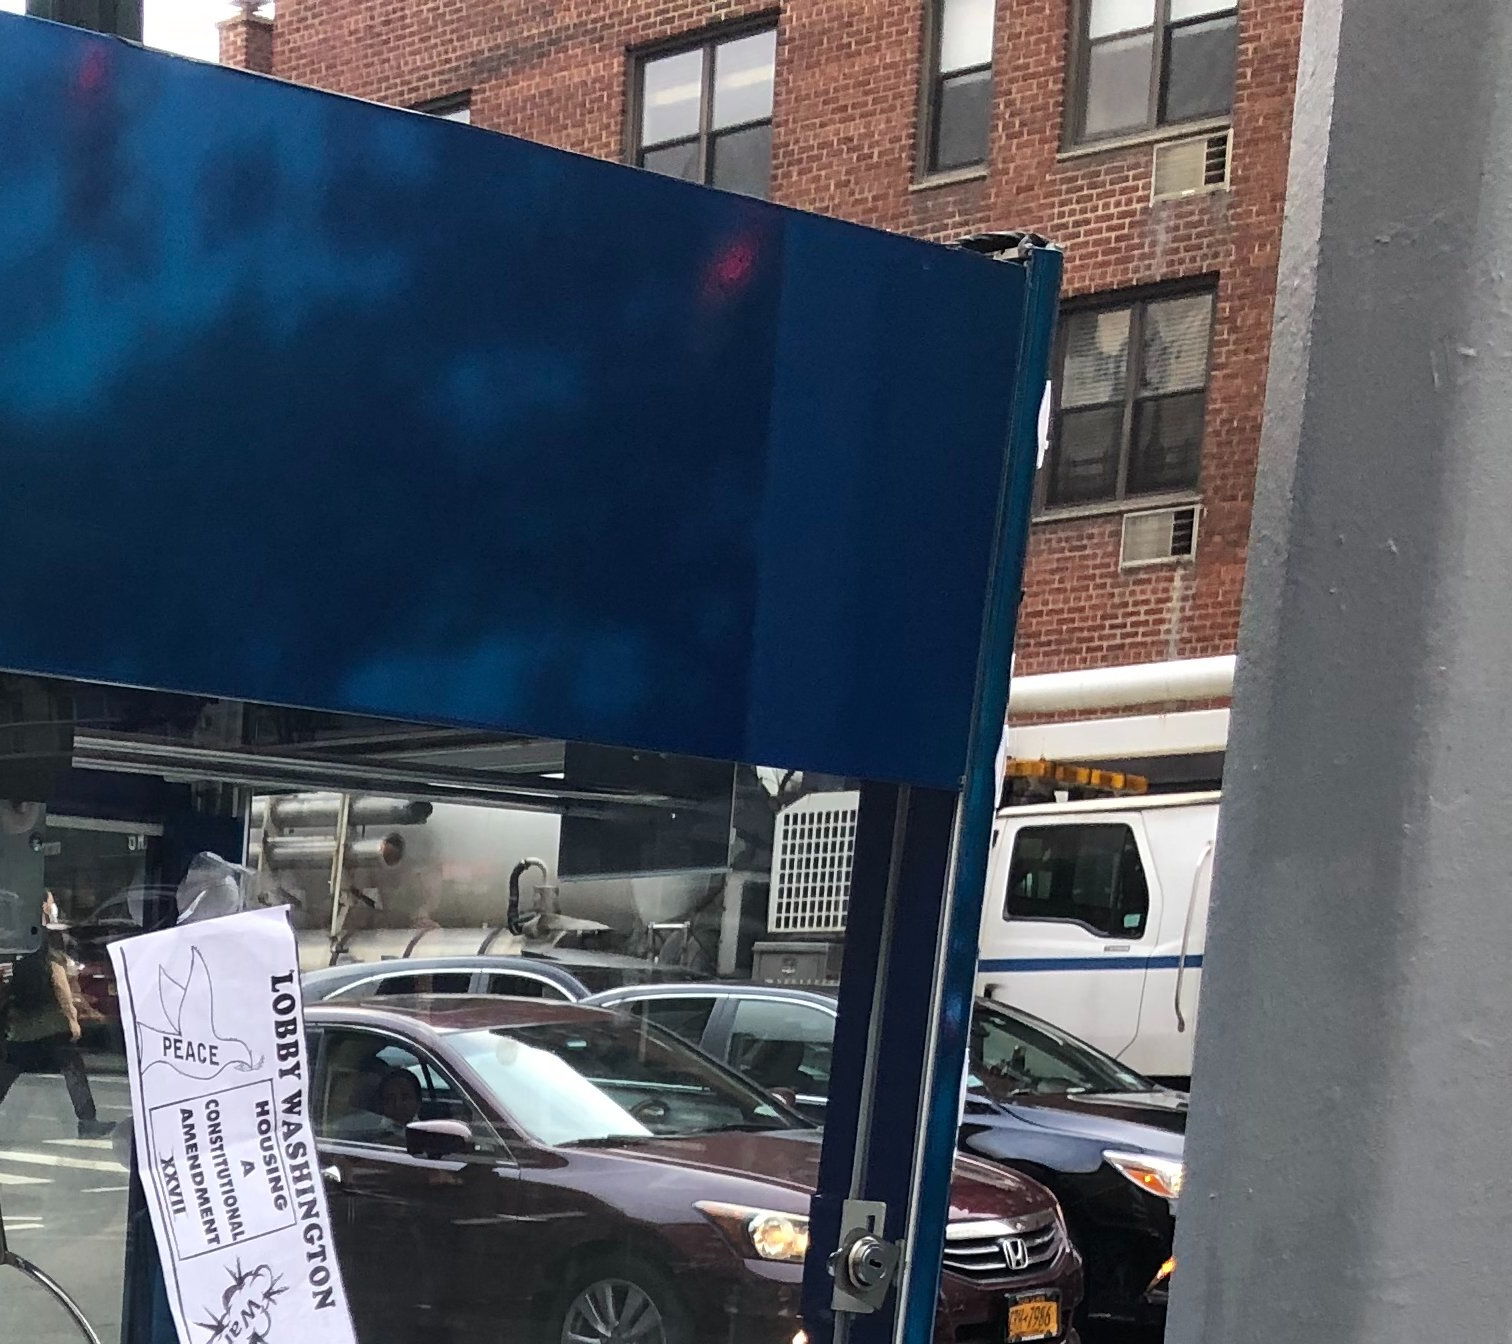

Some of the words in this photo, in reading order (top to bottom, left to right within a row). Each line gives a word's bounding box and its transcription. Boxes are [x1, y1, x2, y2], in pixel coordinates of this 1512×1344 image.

[162, 1036, 220, 1066] PEACE
[270, 972, 302, 1080] LOBBY
[160, 1154, 187, 1216] XXVII
[179, 1108, 221, 1246] AMENDMENT
[204, 1099, 246, 1242] CONSTITUTIONAL
[240, 1160, 256, 1178] A
[255, 1100, 288, 1212] HOUSING
[280, 1089, 336, 1310] WASHINGTON
